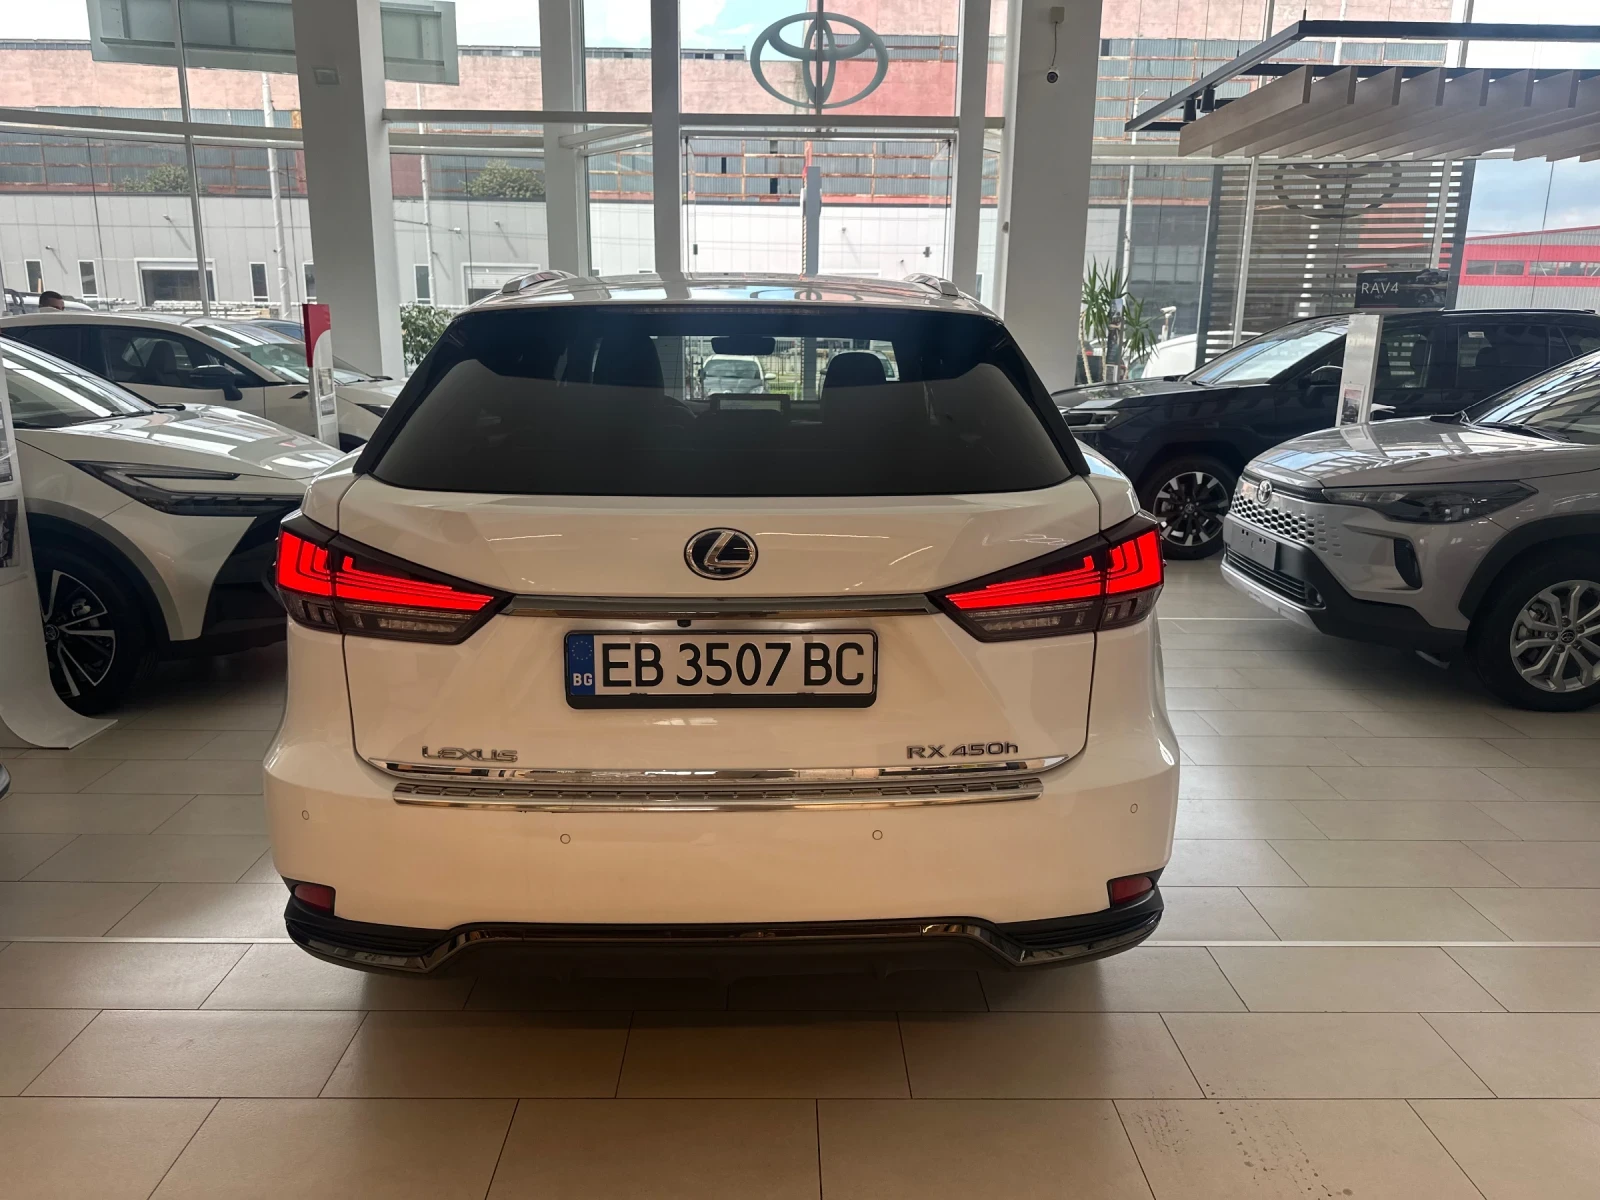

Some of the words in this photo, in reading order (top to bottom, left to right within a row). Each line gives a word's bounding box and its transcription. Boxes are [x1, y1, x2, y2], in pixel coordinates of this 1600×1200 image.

[1361, 282, 1399, 294] RAV4
[602, 643, 664, 687] EB
[676, 642, 791, 687] 3507
[804, 642, 864, 686] BC
[573, 672, 593, 686] BG
[422, 745, 518, 763] LEXUS
[906, 744, 947, 759] RX
[949, 741, 1019, 757] 450h
